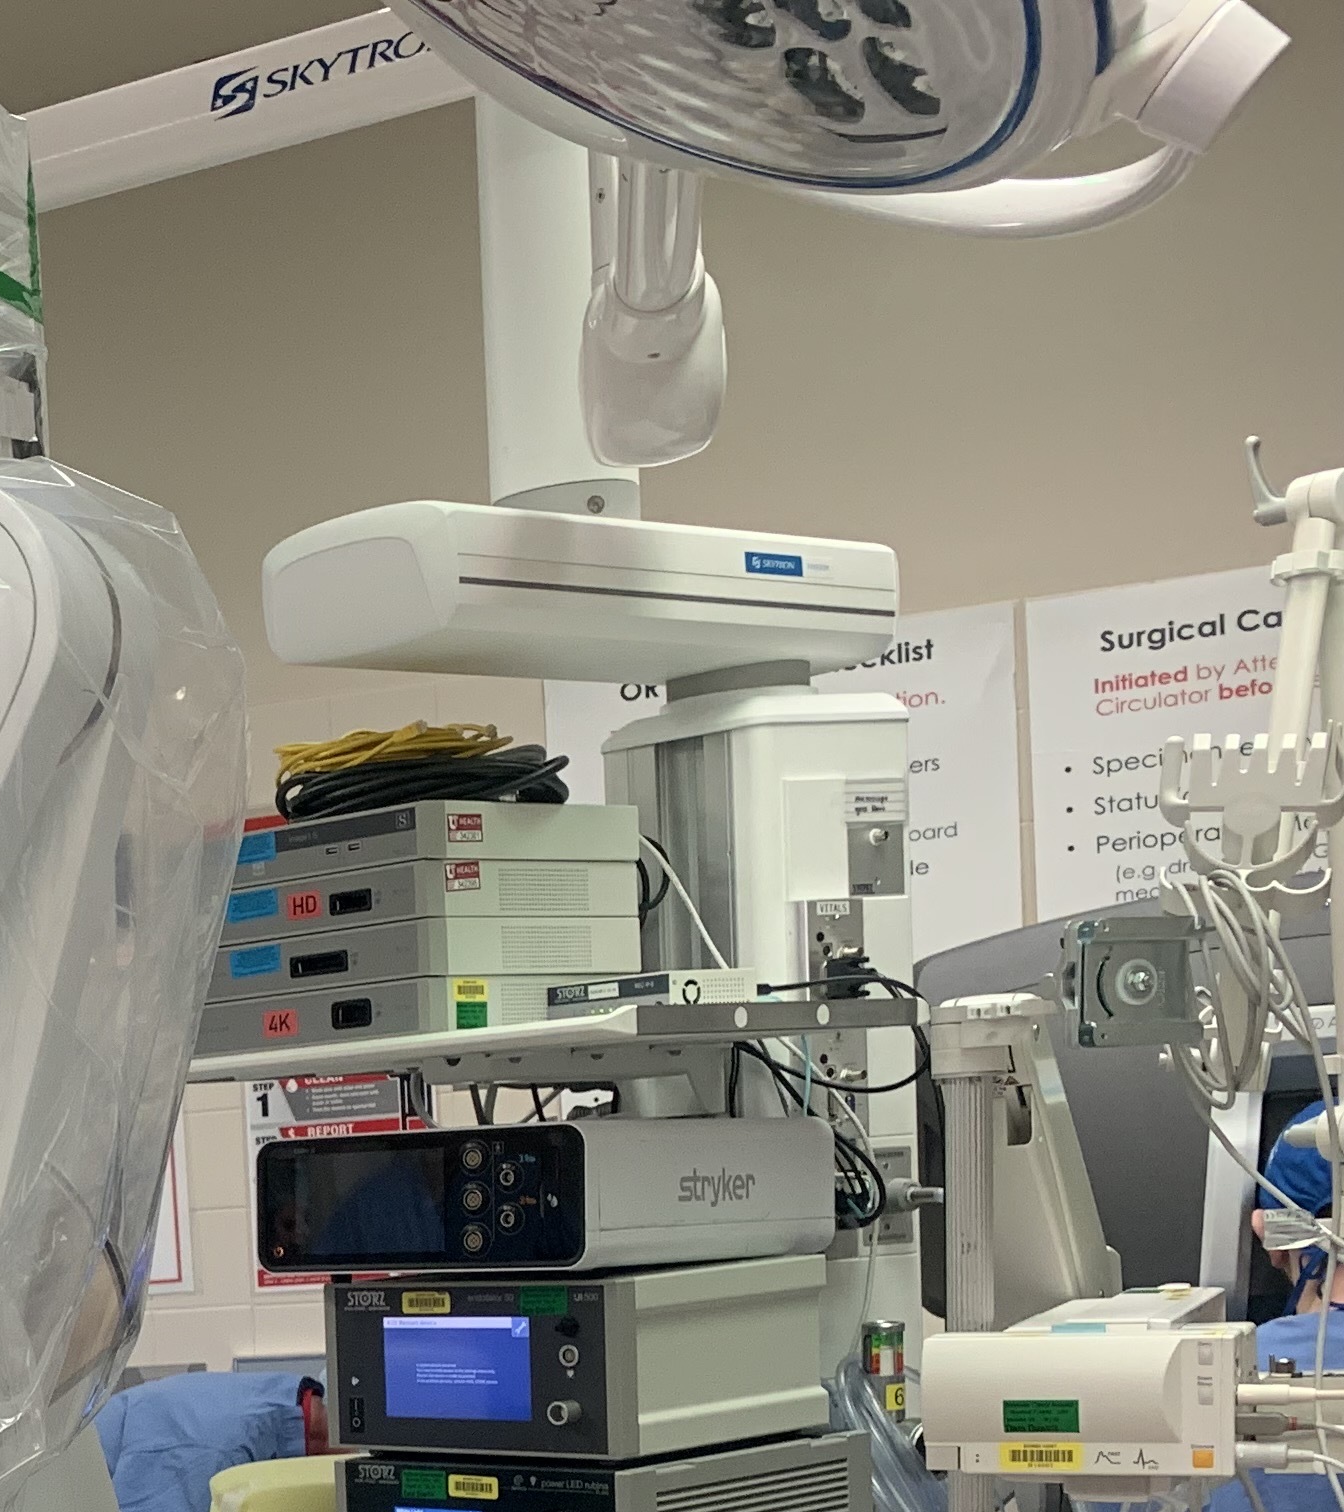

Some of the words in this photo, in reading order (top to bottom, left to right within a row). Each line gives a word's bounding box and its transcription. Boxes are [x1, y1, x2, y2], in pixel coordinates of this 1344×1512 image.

[263, 31, 431, 98] SKYTRO
[1099, 613, 1226, 653] Surgical
[1094, 666, 1188, 695] Initiated
[1195, 661, 1227, 684] by
[1095, 687, 1213, 717] Circulator
[1218, 680, 1273, 702] befo
[909, 754, 940, 774] ers
[459, 816, 481, 826] HEALTH
[456, 865, 479, 875] HEALTH
[292, 895, 317, 916] HD
[819, 902, 847, 914] VITALS
[556, 985, 585, 999] STORZ
[268, 1012, 291, 1033] 4K
[252, 1082, 274, 1092] STEP
[256, 1093, 269, 1117] 1
[307, 1123, 355, 1138] REPORT
[677, 1167, 755, 1208] stryker
[347, 1291, 387, 1306] STORZ
[895, 1387, 904, 1406] 6
[358, 1464, 396, 1480] STORZ
